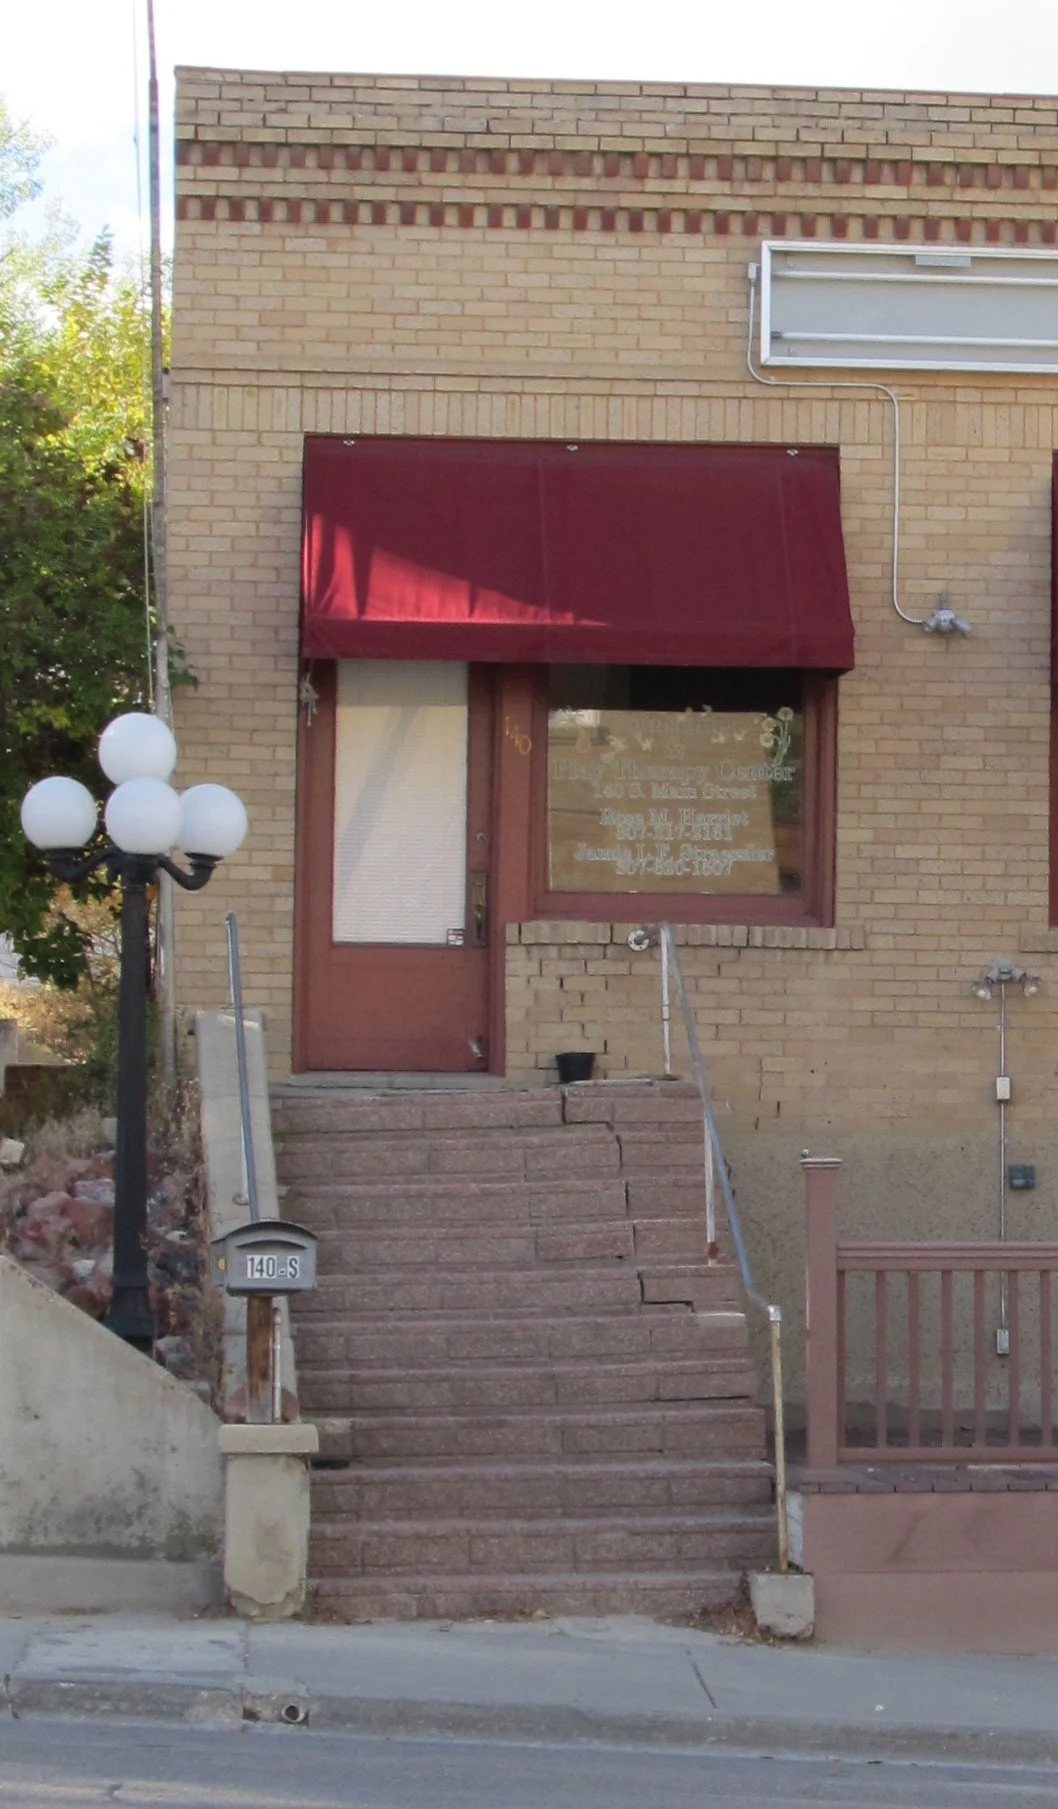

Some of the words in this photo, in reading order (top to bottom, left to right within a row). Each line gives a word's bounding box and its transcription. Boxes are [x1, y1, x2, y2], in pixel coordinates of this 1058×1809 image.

[552, 759, 607, 783] Play
[614, 759, 711, 784] Therapy
[716, 759, 800, 781] Center
[593, 782, 624, 799] 140
[650, 781, 698, 799] Main
[701, 782, 758, 800] Street
